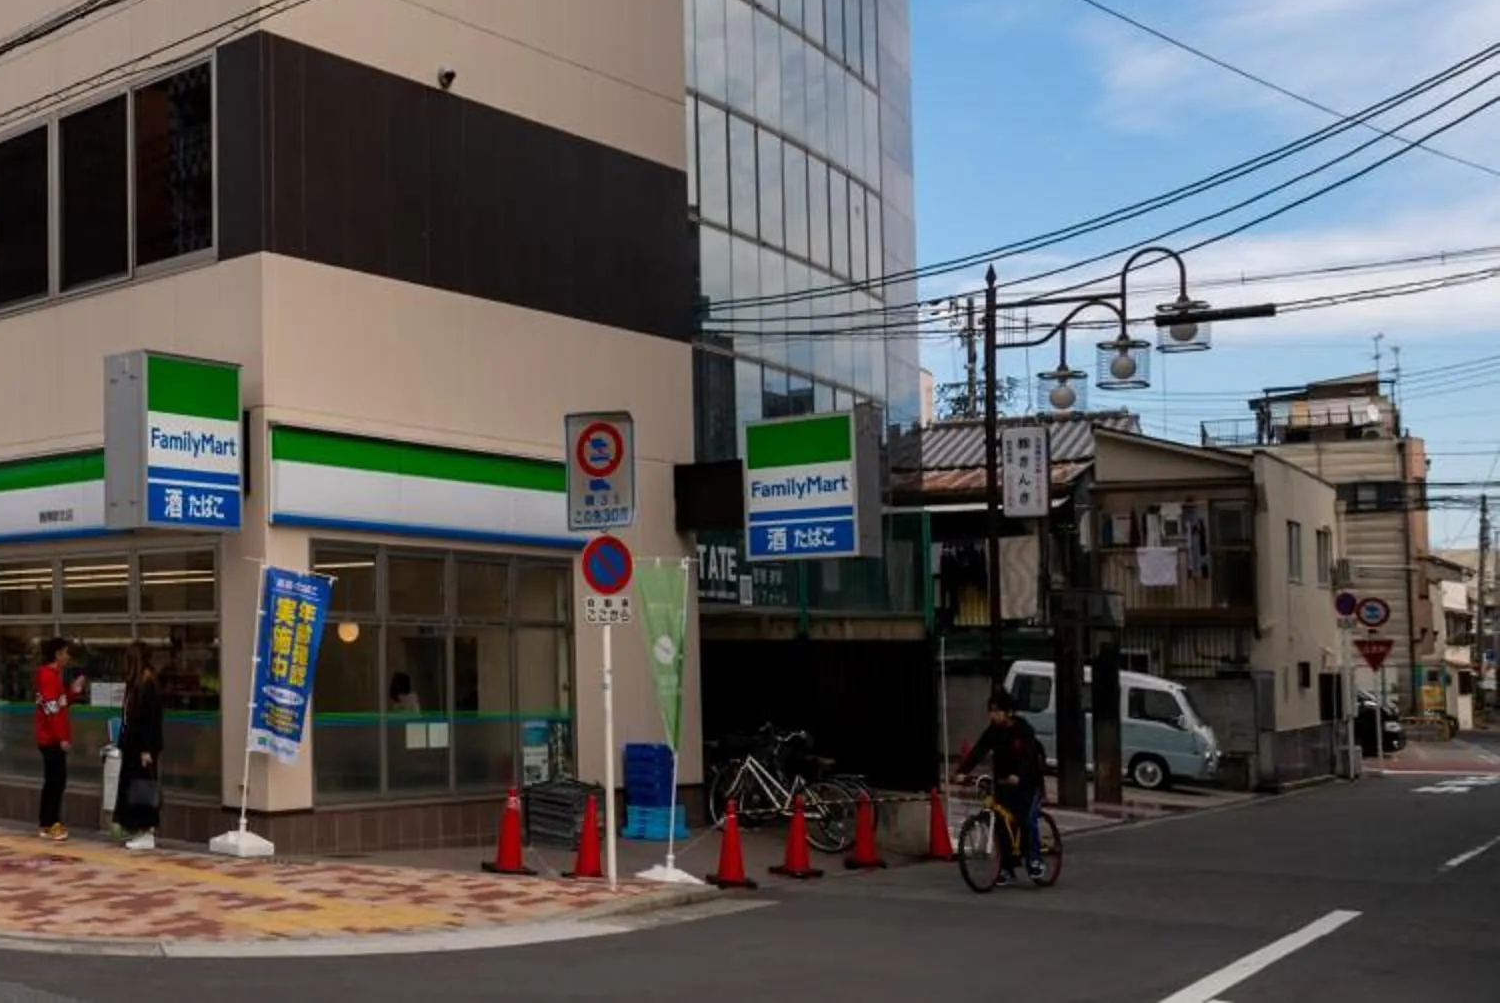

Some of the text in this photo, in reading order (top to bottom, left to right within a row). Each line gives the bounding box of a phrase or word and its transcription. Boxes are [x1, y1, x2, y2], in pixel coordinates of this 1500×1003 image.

[150, 426, 237, 459] FamilyMart
[751, 474, 849, 500] FamilyMart
[164, 487, 226, 519] 酒 たばこ
[767, 527, 837, 552] 酒 たばこ
